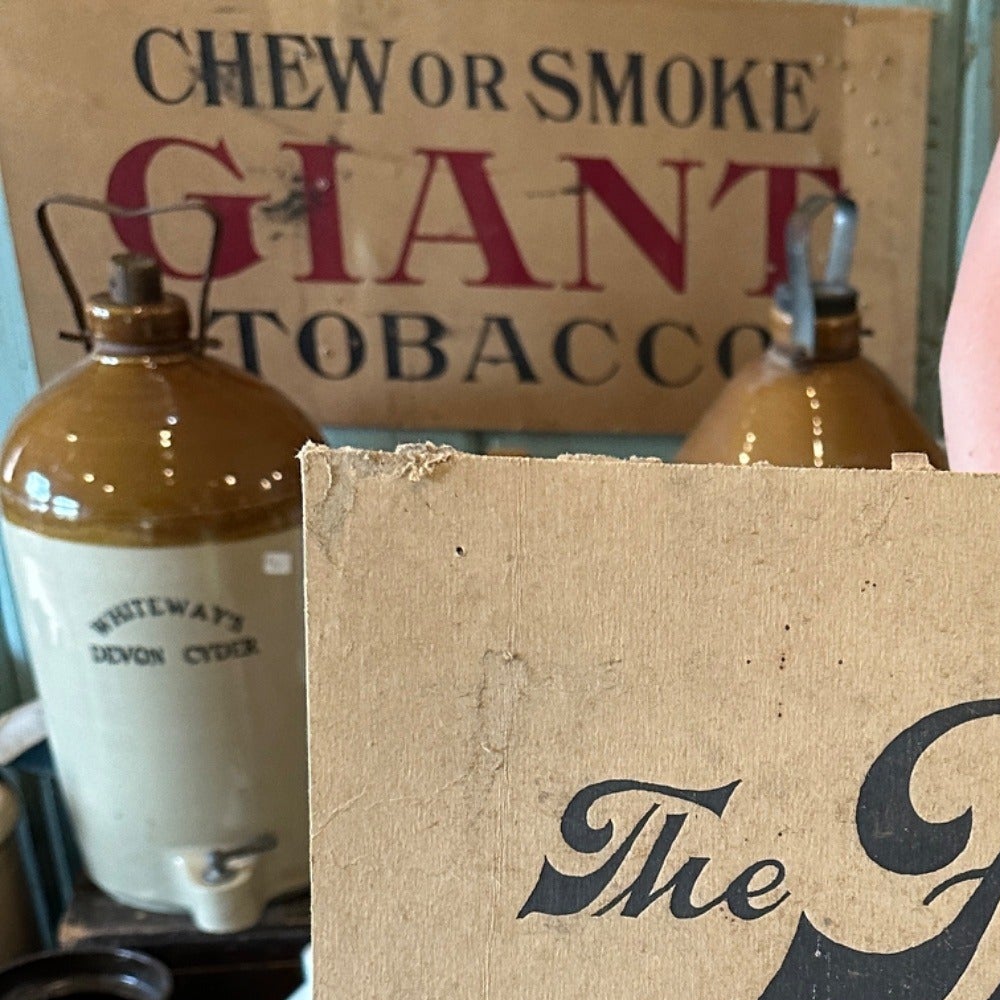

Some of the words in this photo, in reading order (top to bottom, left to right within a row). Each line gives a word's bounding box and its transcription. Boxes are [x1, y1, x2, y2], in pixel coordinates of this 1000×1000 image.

[133, 27, 395, 114] CHEW
[410, 51, 508, 112] OR
[526, 48, 820, 134] SMOKE
[106, 136, 846, 298] GIANT
[206, 309, 775, 388] TOBACCO
[89, 643, 165, 666] DEVON
[516, 779, 791, 920] The
